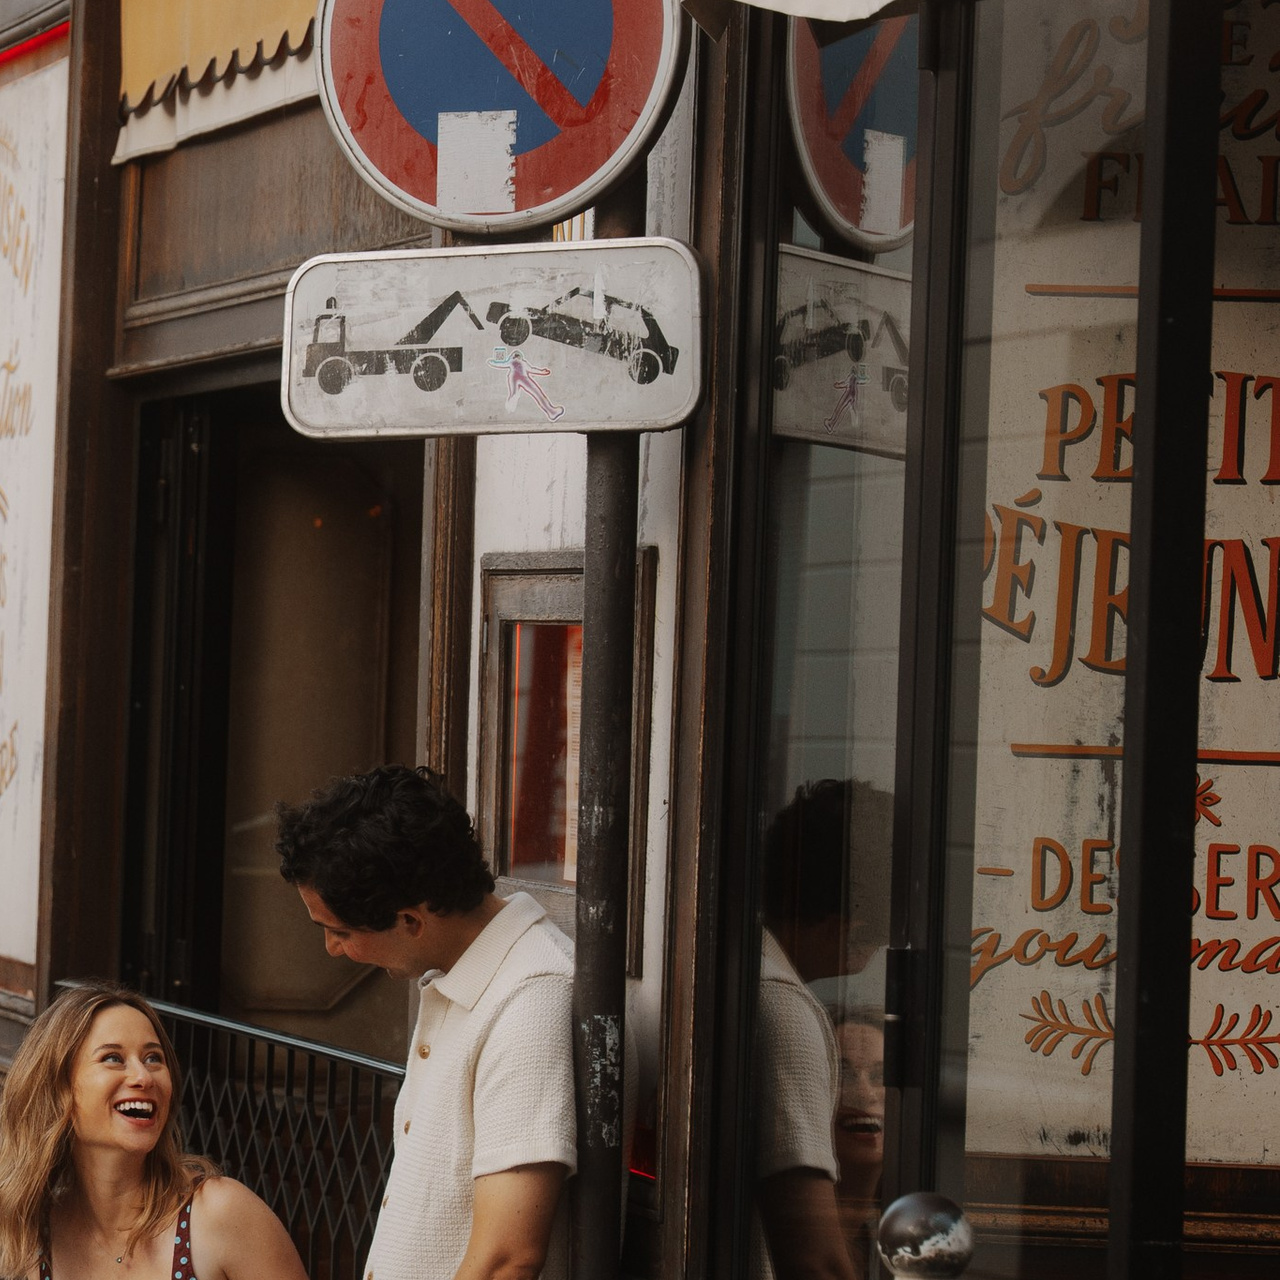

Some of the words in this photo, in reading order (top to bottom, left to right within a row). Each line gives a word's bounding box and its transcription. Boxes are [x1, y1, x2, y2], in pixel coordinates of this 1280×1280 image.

[1080, 150, 1280, 226] FAI
[1036, 370, 1280, 486] PEIT
[981, 487, 1280, 688] ÉJEN
[1030, 836, 1280, 921] DEER
[969, 926, 1280, 993] gouma
